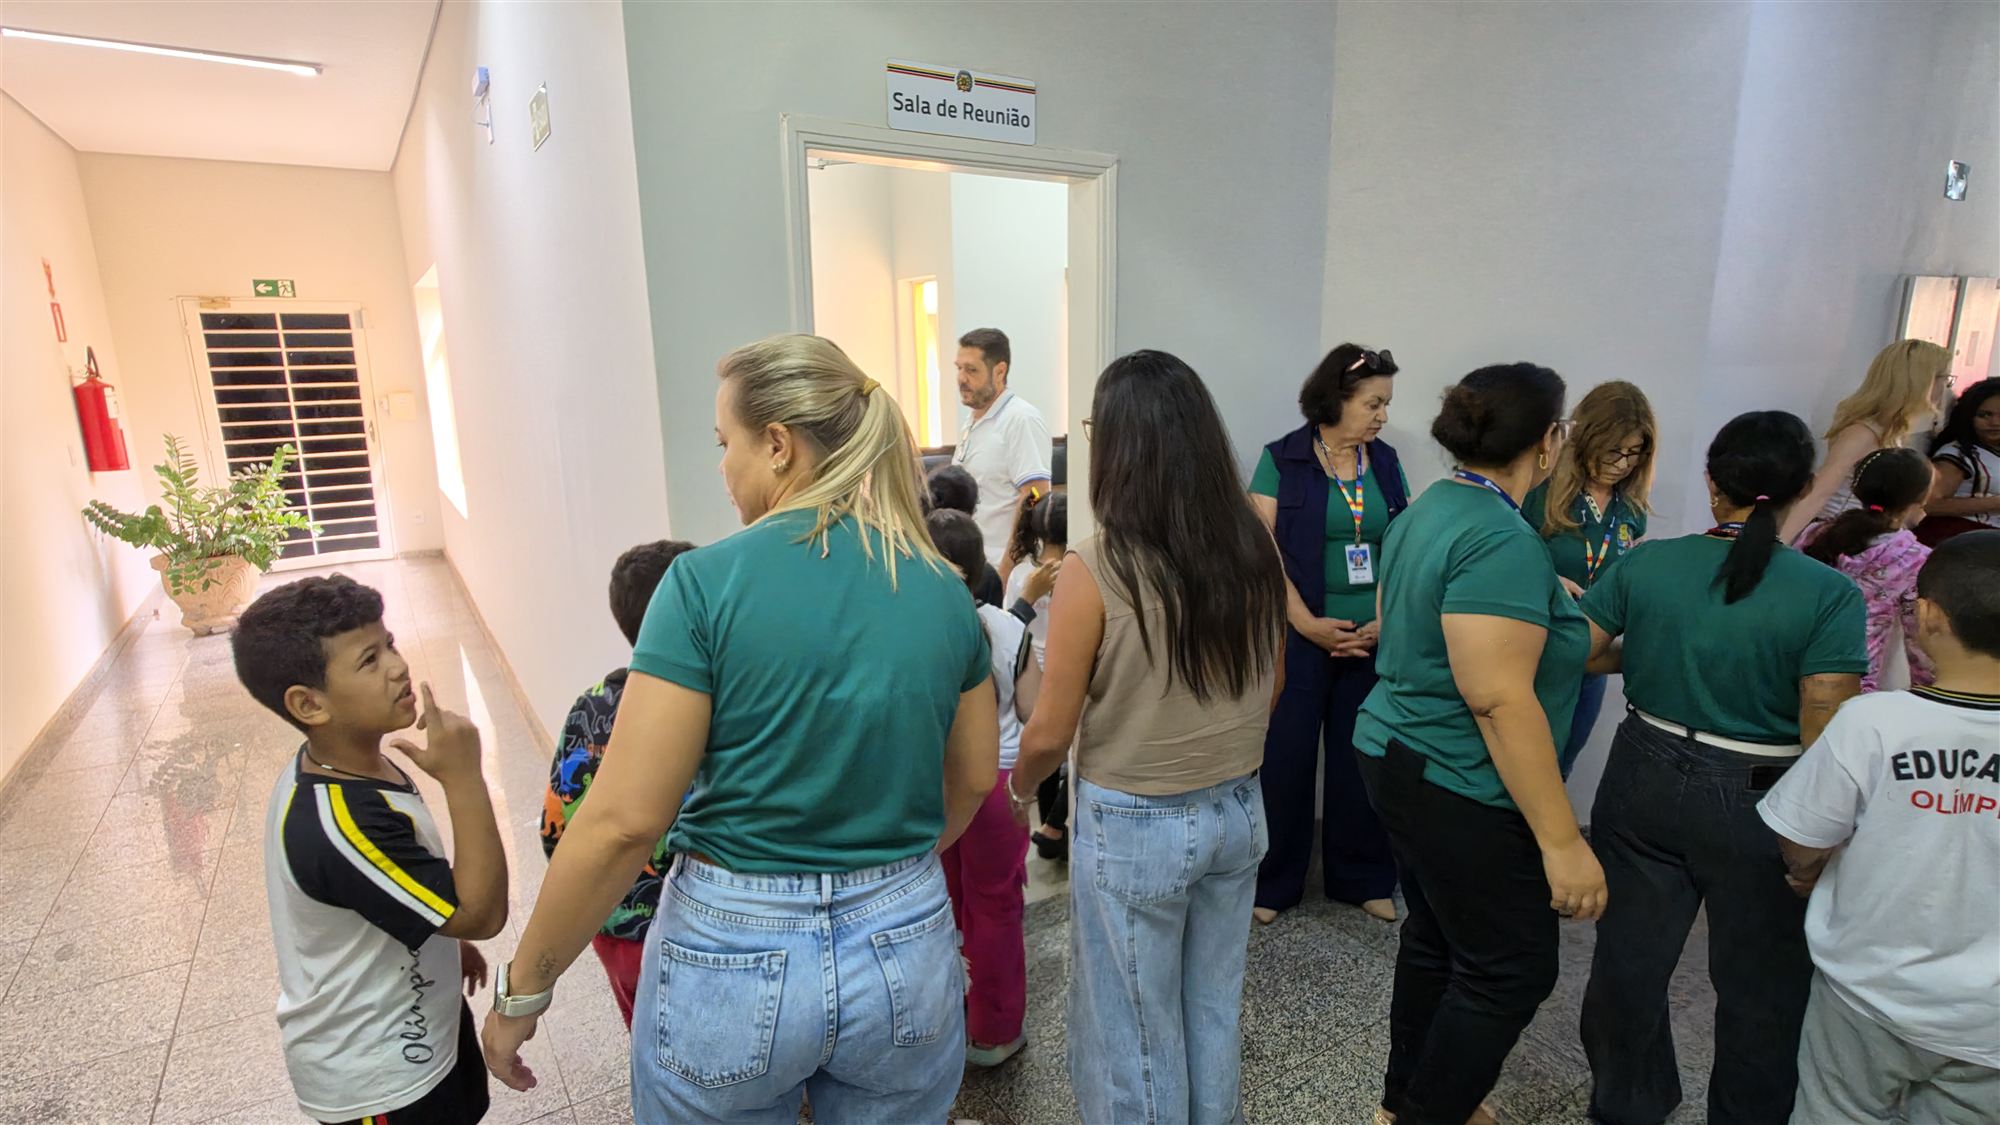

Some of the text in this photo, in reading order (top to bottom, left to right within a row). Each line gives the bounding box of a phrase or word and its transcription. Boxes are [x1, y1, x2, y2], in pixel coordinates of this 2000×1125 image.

[893, 92, 1031, 128] Sala de Reunião
[1891, 749, 2000, 783] EDUCA
